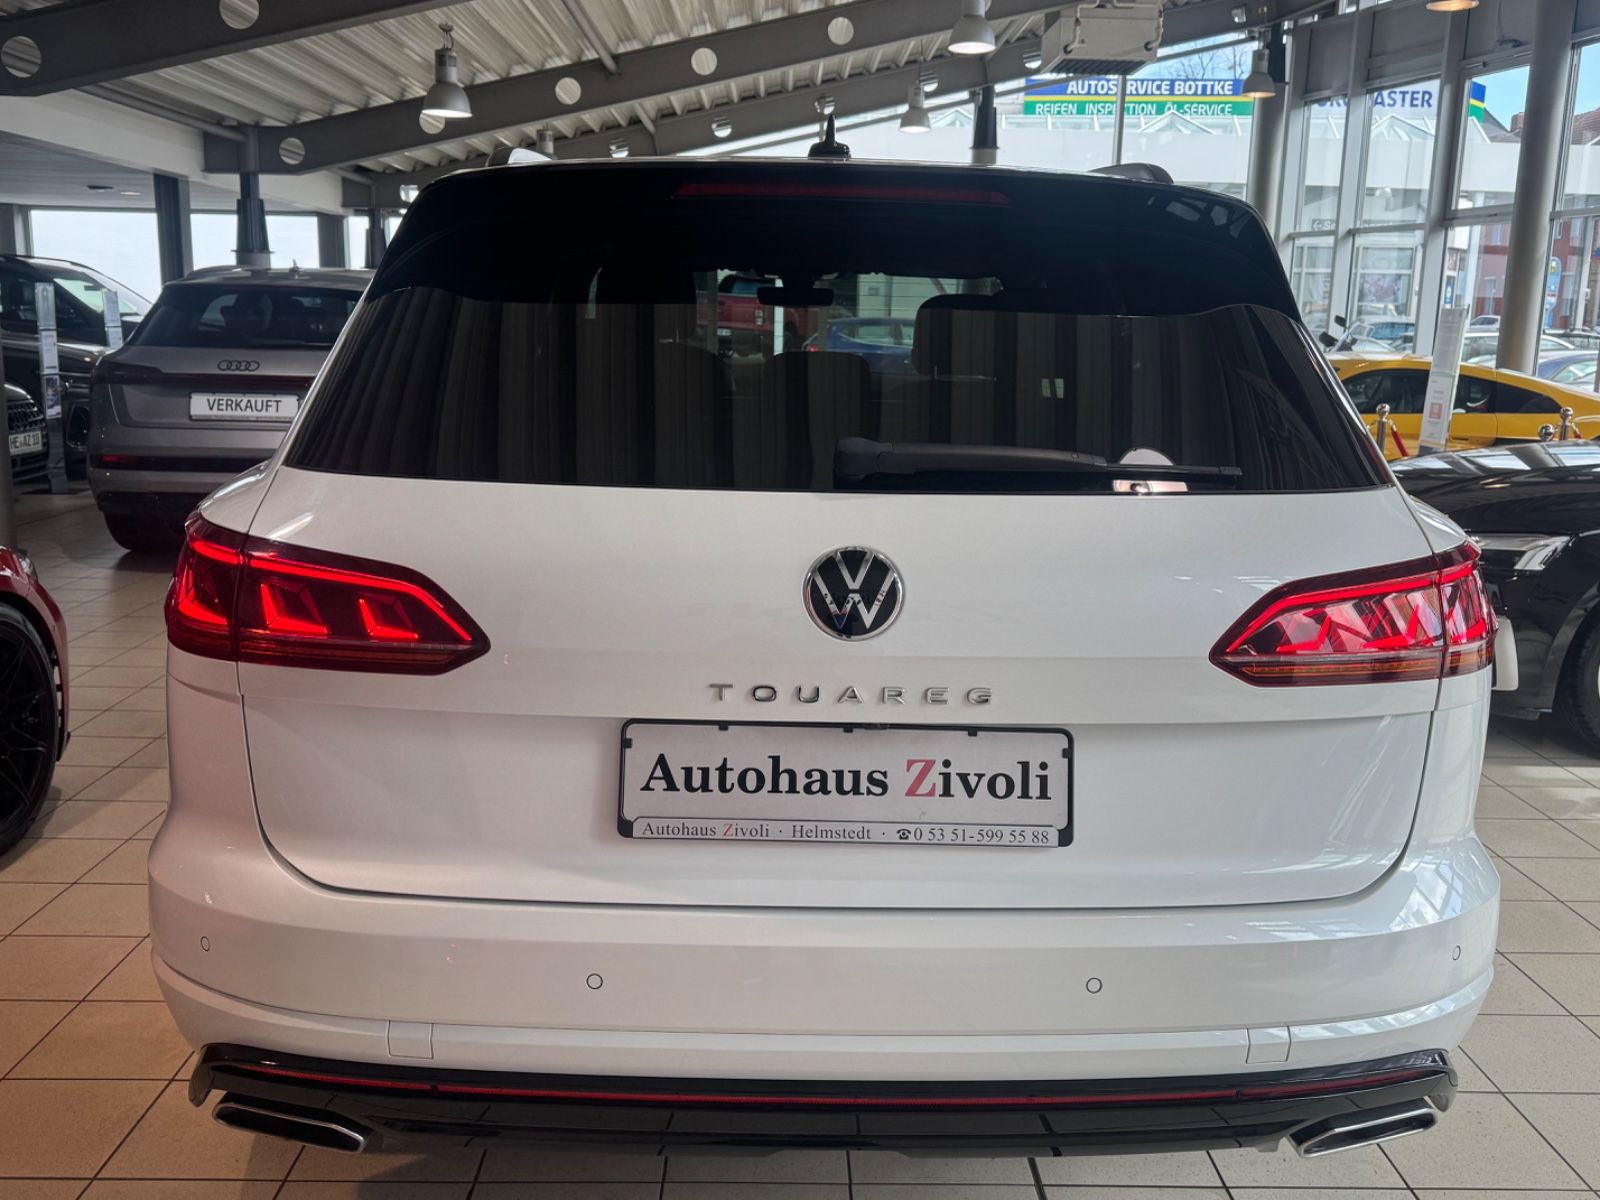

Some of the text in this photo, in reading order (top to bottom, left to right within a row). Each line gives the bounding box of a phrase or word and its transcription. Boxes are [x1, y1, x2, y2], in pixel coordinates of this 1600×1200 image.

[1066, 80, 1233, 95] AUTOSRVICE BOTTKE
[1035, 102, 1078, 115] REIFEN
[1085, 103, 1157, 115] INSPTION
[206, 398, 282, 413] VERKAUFT
[708, 683, 993, 705] TOUAREG
[640, 753, 1053, 801] Autohaus Zivoli
[642, 822, 717, 837] Autohaus
[723, 823, 770, 838] Zivoli
[792, 824, 871, 840] Helmstedt
[927, 827, 945, 842] 53
[951, 828, 1004, 843] 51-599
[1009, 829, 1026, 844] 55
[1031, 829, 1049, 844] 88
